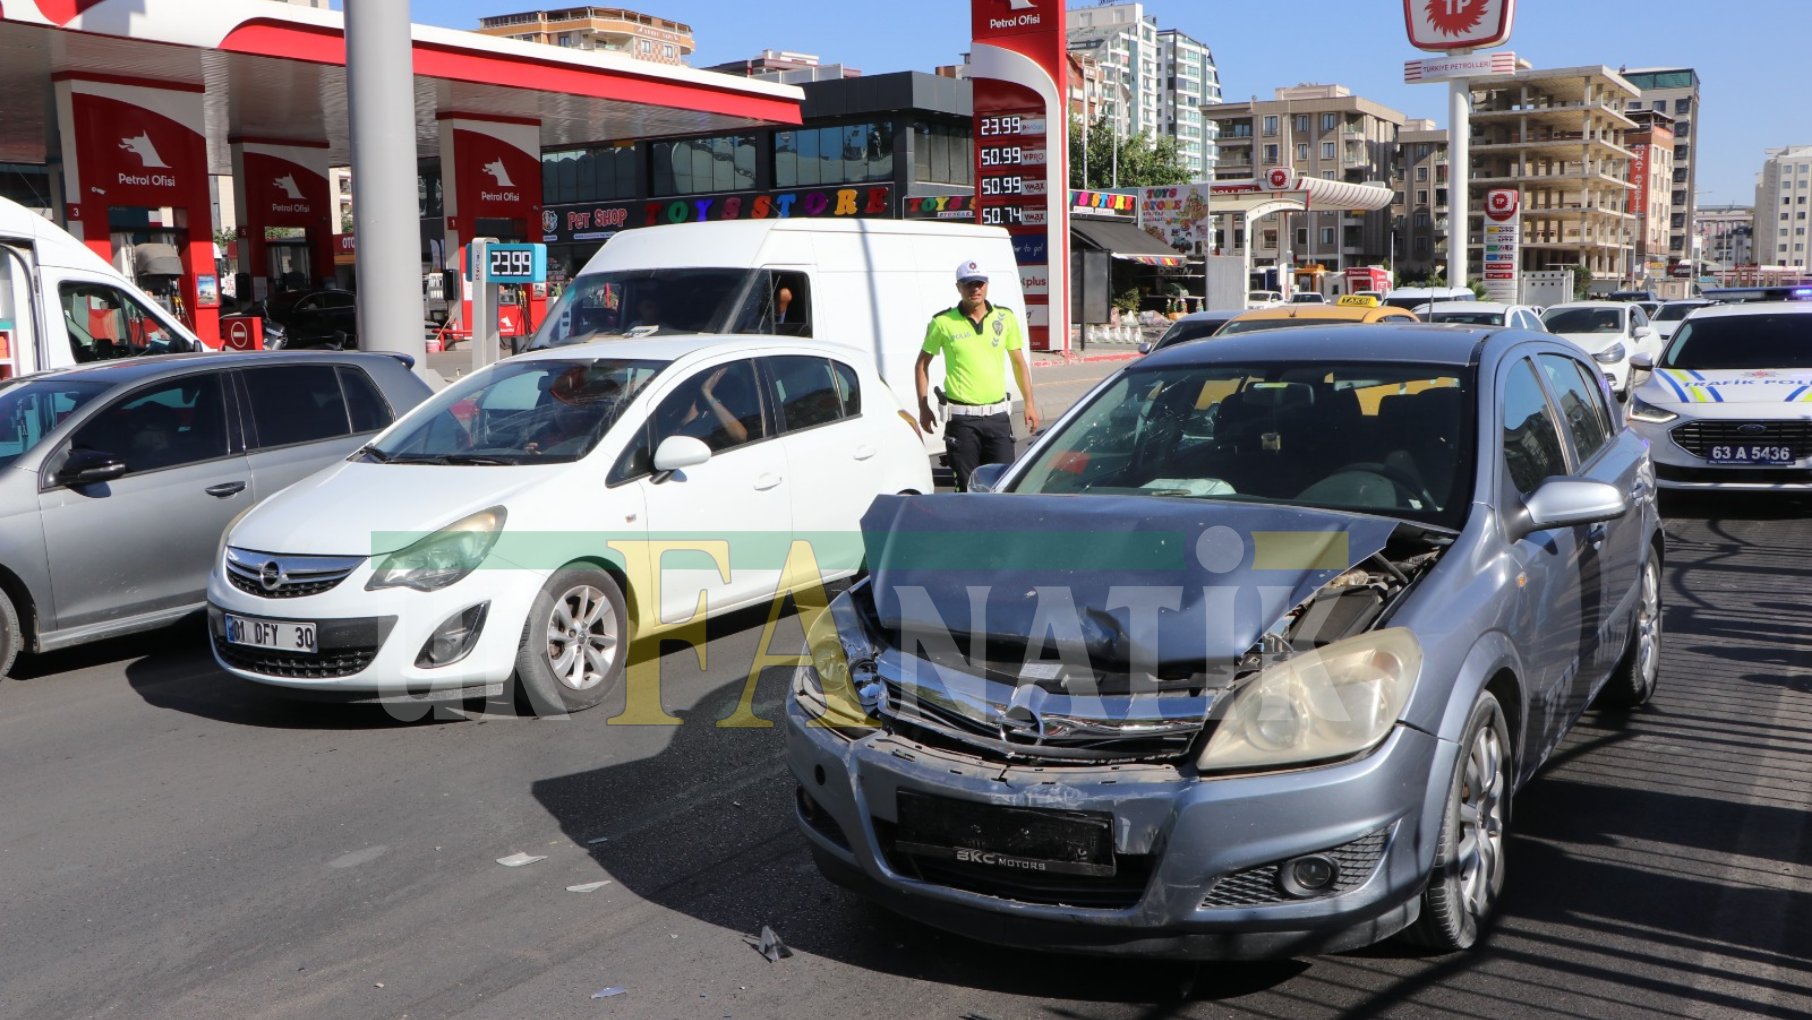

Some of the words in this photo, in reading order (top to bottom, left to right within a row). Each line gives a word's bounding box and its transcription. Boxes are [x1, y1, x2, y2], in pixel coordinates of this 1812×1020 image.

[990, 17, 1016, 29] Petrol
[1018, 14, 1040, 26] Ofisi
[1450, 60, 1491, 71] PETROLLERİ
[981, 117, 1020, 136] 23.99
[982, 147, 1021, 165] 50.99
[118, 172, 150, 186] Petrol
[151, 174, 176, 187] Ofisi
[982, 177, 1021, 195] 50.99
[481, 191, 502, 201] Petrol
[504, 192, 520, 202] Ofisi
[909, 196, 963, 212] TOYS
[1091, 193, 1134, 211] STORE
[73, 207, 79, 217] 3
[272, 203, 293, 212] Petrol
[294, 204, 310, 213] Ofisi
[643, 196, 742, 226] TOYS
[751, 187, 888, 219] STORE
[594, 208, 628, 227] SHOP
[983, 207, 1022, 225] 50.74
[491, 251, 532, 275] 23.99
[1683, 378, 1754, 387] TRAFİK
[1712, 446, 1731, 459] 63
[1735, 446, 1747, 460] A
[1751, 446, 1790, 461] 5436
[233, 619, 246, 642] 01
[254, 621, 279, 646] DFY
[295, 626, 315, 648] 30
[956, 850, 996, 865] BKC
[998, 858, 1046, 871] MOTORS
